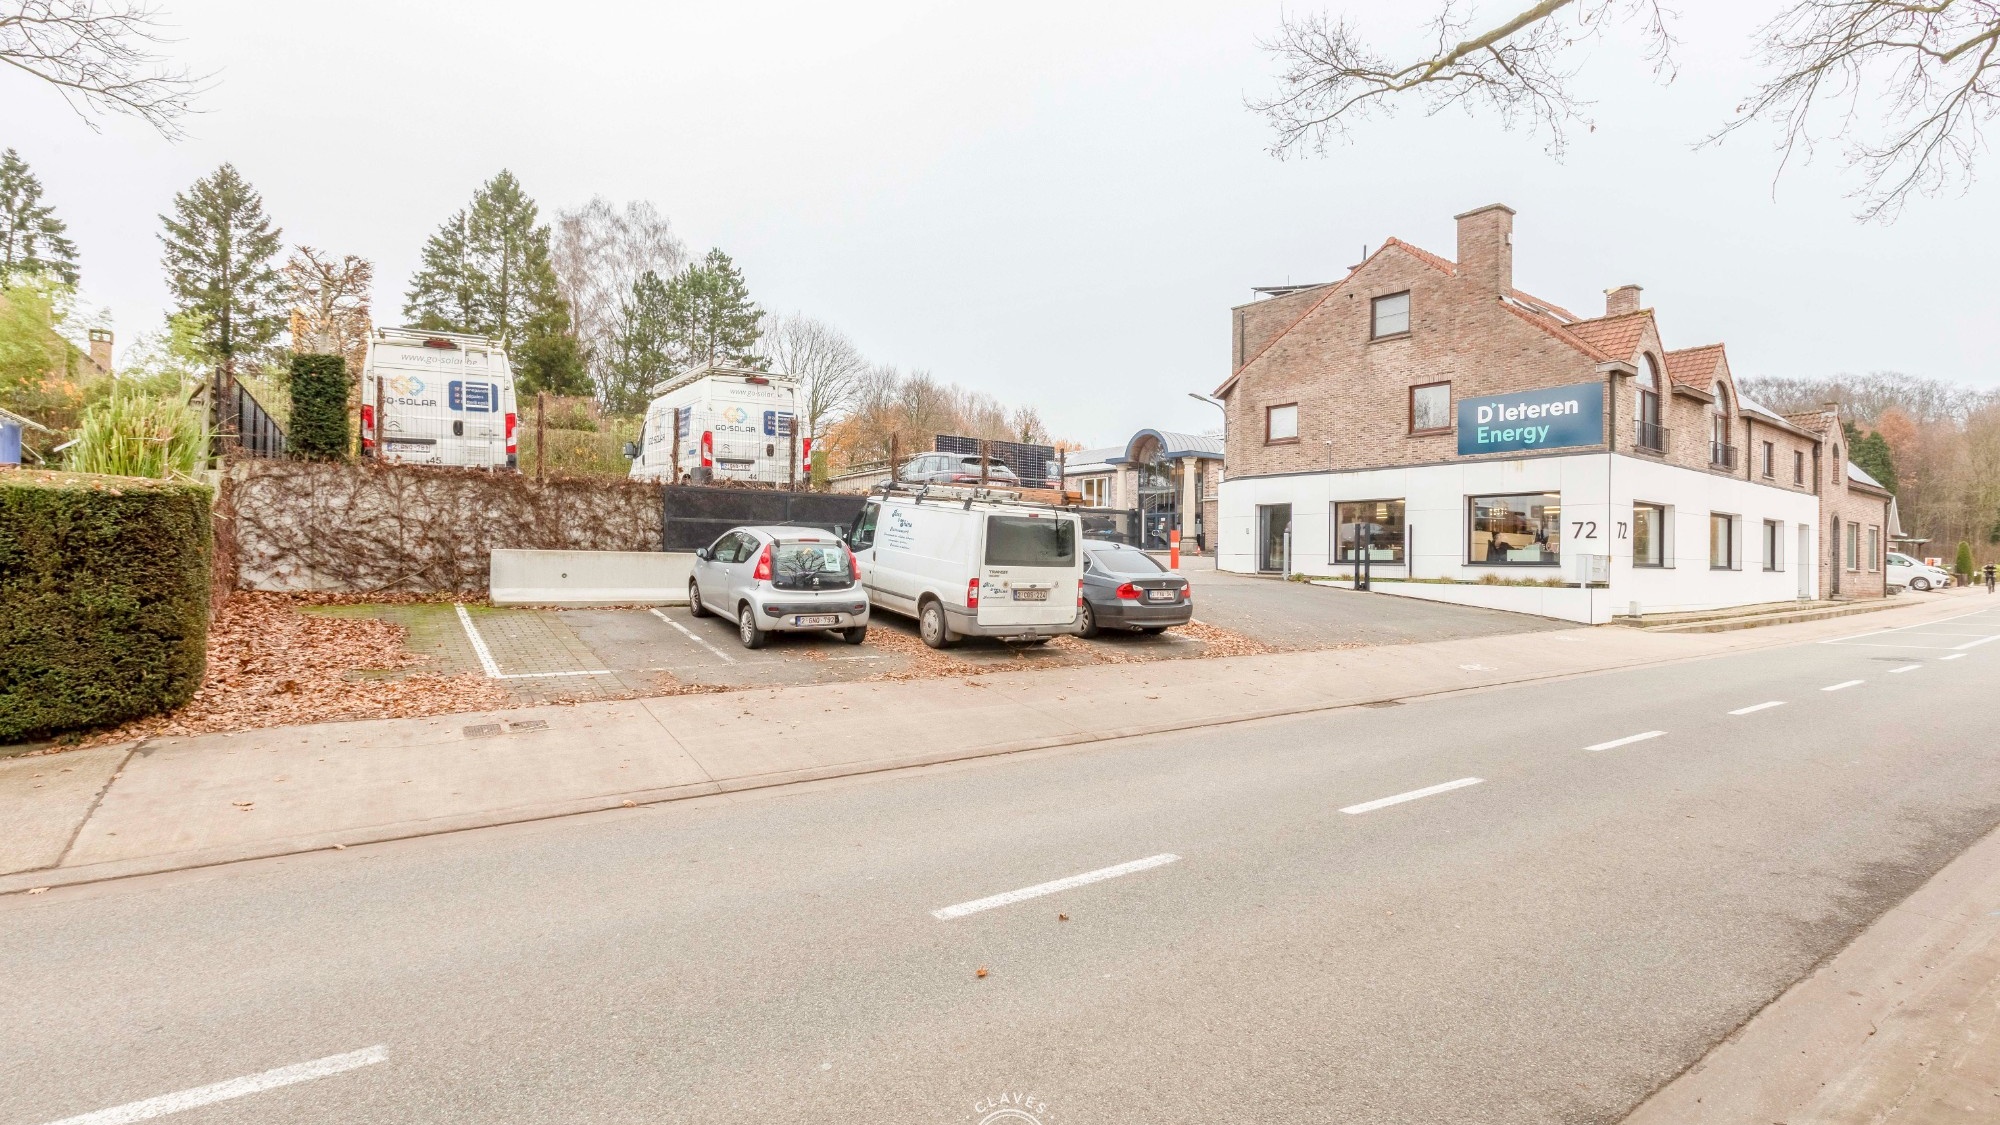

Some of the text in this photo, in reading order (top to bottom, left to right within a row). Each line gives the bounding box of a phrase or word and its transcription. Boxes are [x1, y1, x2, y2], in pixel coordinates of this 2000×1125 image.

[401, 354, 478, 365] www.go-solarbe
[385, 396, 437, 407] O-SOLAR
[1477, 424, 1550, 444] Energy
[1571, 521, 1598, 539] 72
[1616, 521, 1628, 540] 72
